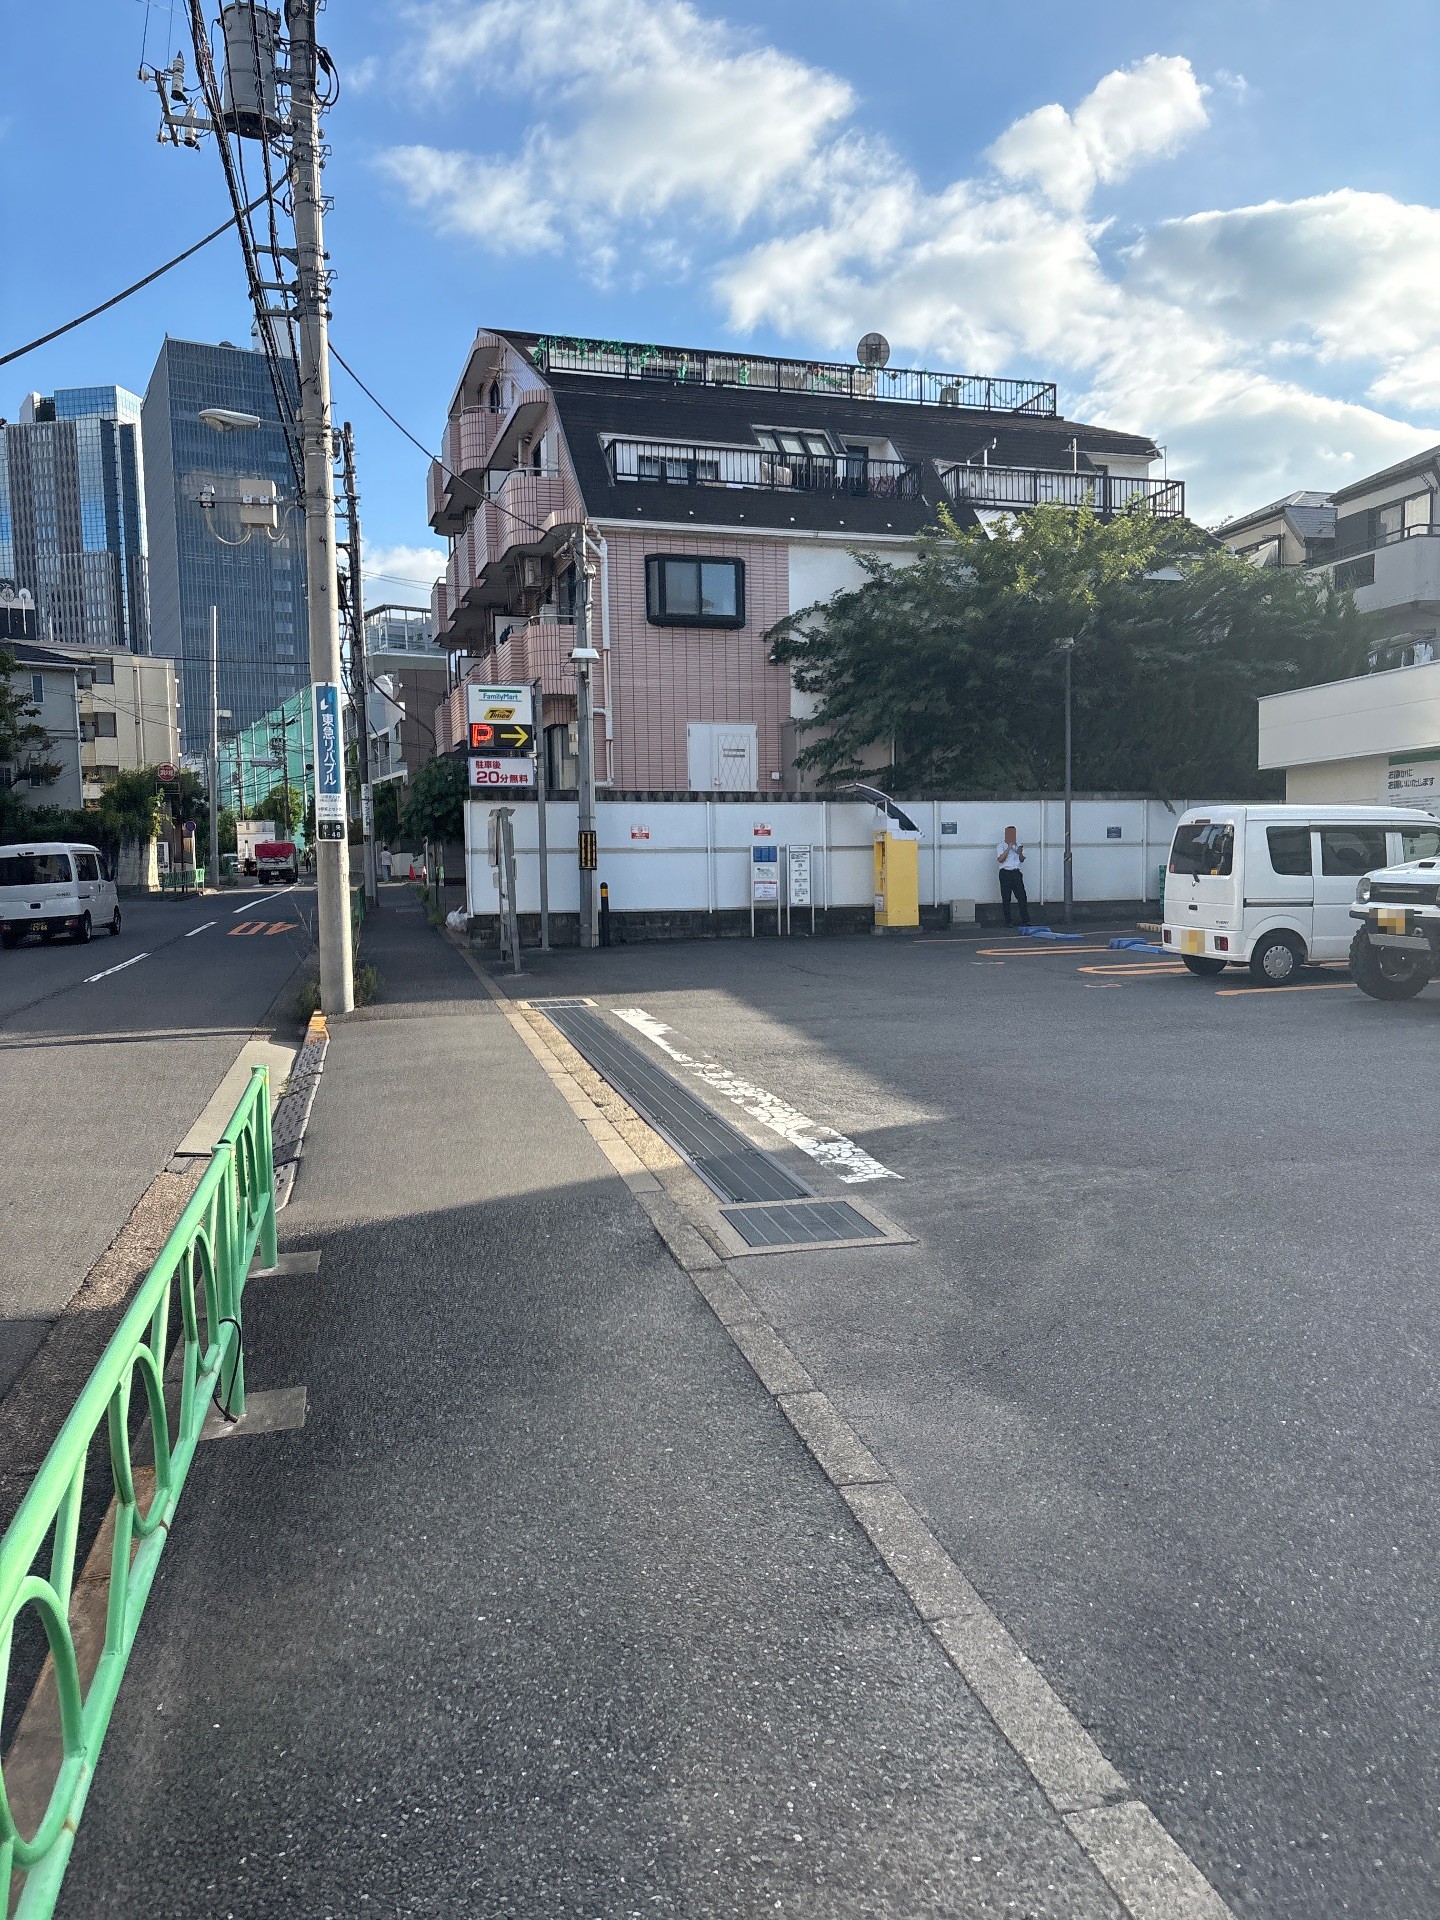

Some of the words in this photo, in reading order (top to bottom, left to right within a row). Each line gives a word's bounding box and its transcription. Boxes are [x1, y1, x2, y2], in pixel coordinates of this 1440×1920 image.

[483, 692, 518, 700] FamilyMart
[472, 724, 493, 748] P
[321, 713, 337, 786] 東急リバブル
[475, 760, 501, 770] 駐車後
[476, 771, 528, 784] 20分無料
